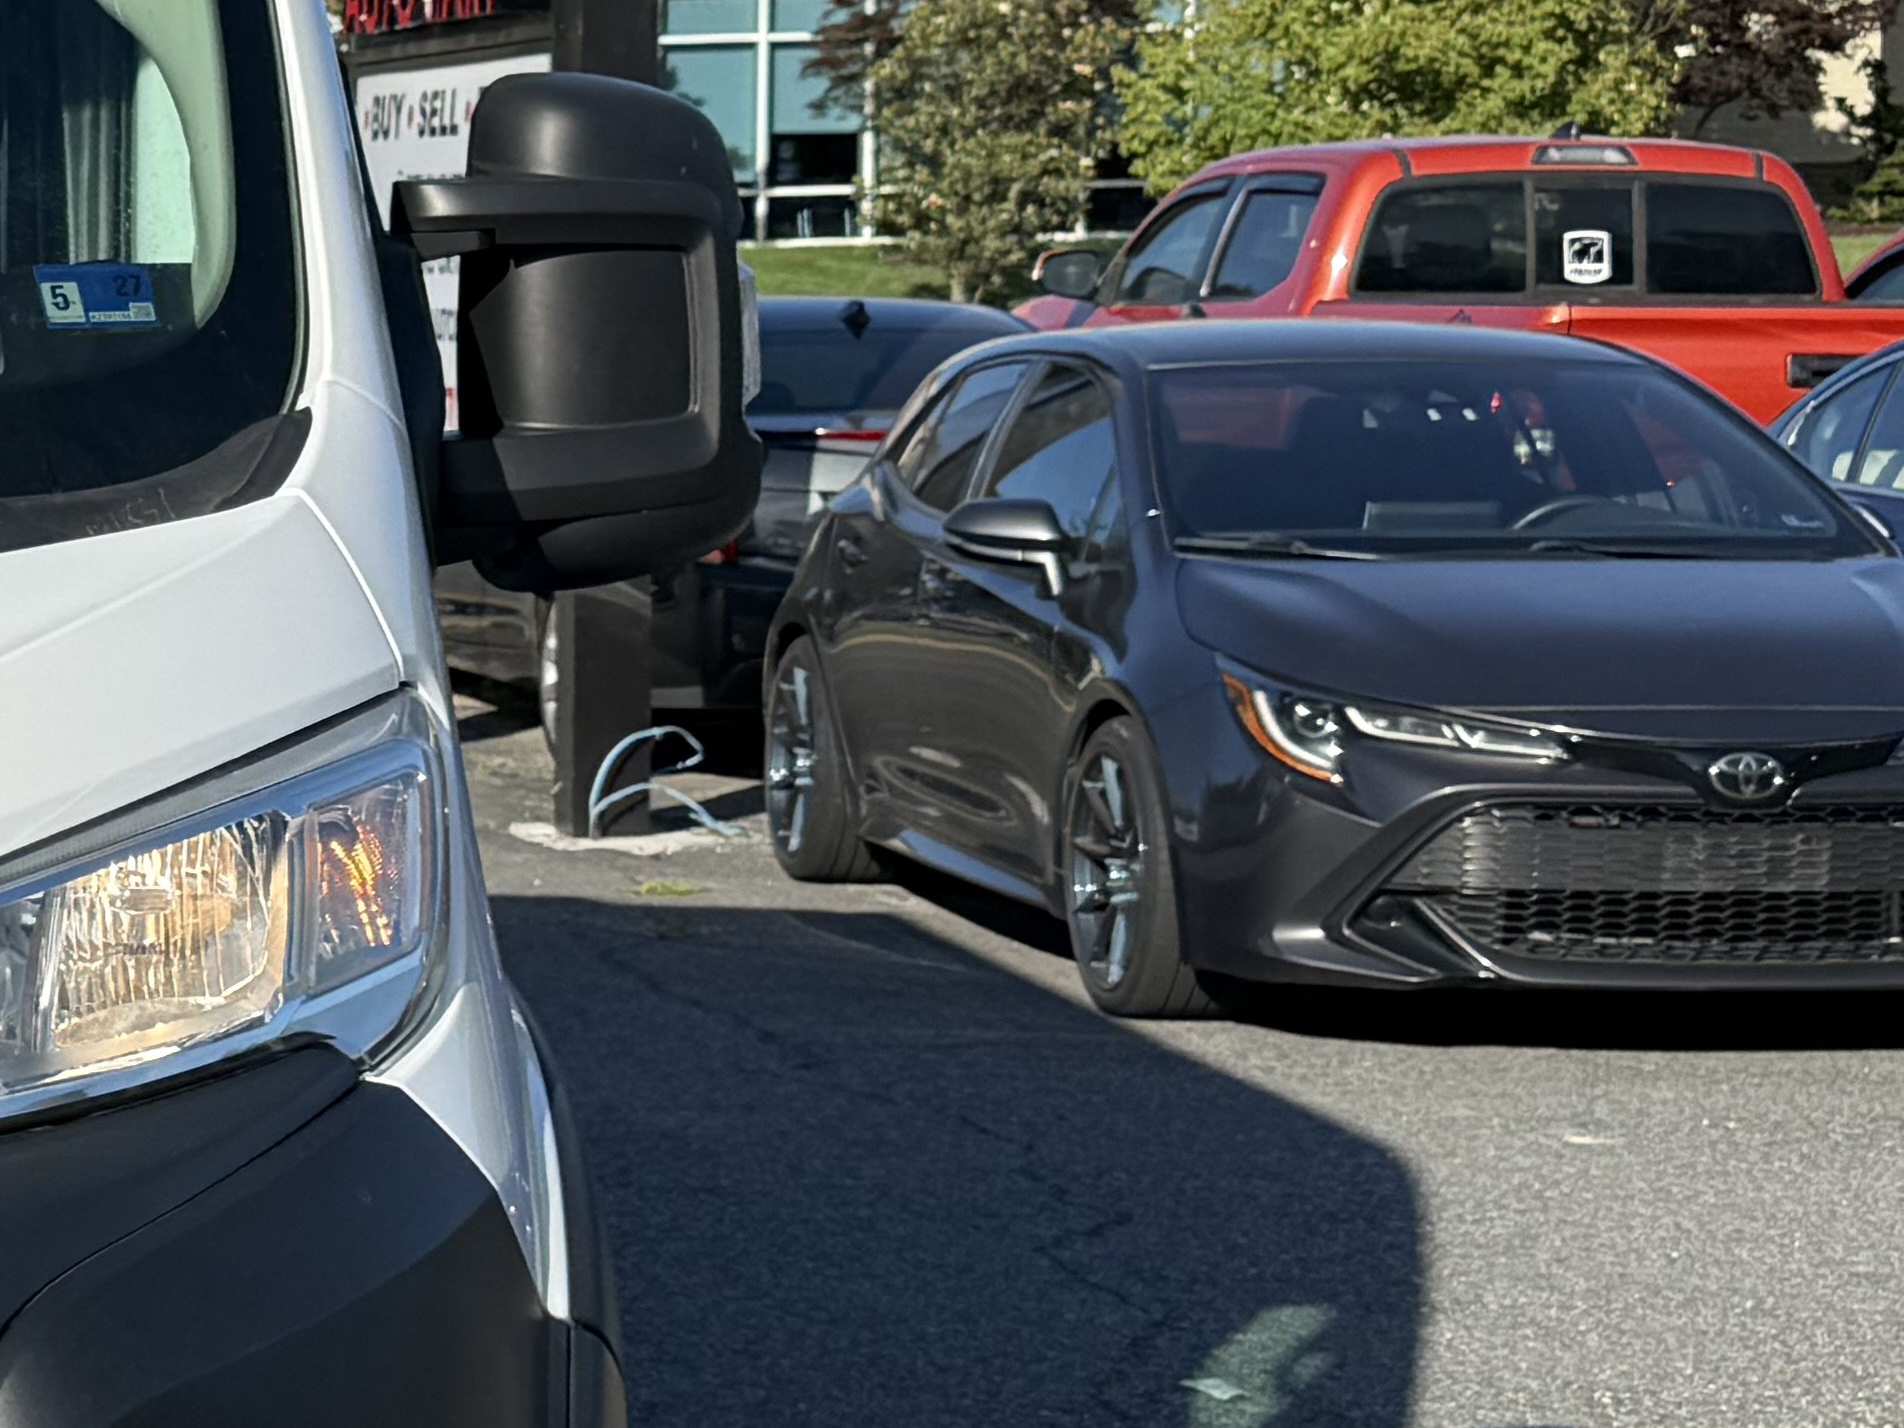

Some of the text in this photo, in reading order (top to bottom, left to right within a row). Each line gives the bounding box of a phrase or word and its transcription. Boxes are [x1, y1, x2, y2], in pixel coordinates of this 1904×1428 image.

[371, 87, 459, 142] BUY SELL
[49, 284, 71, 311] 5
[113, 274, 142, 297] 27
